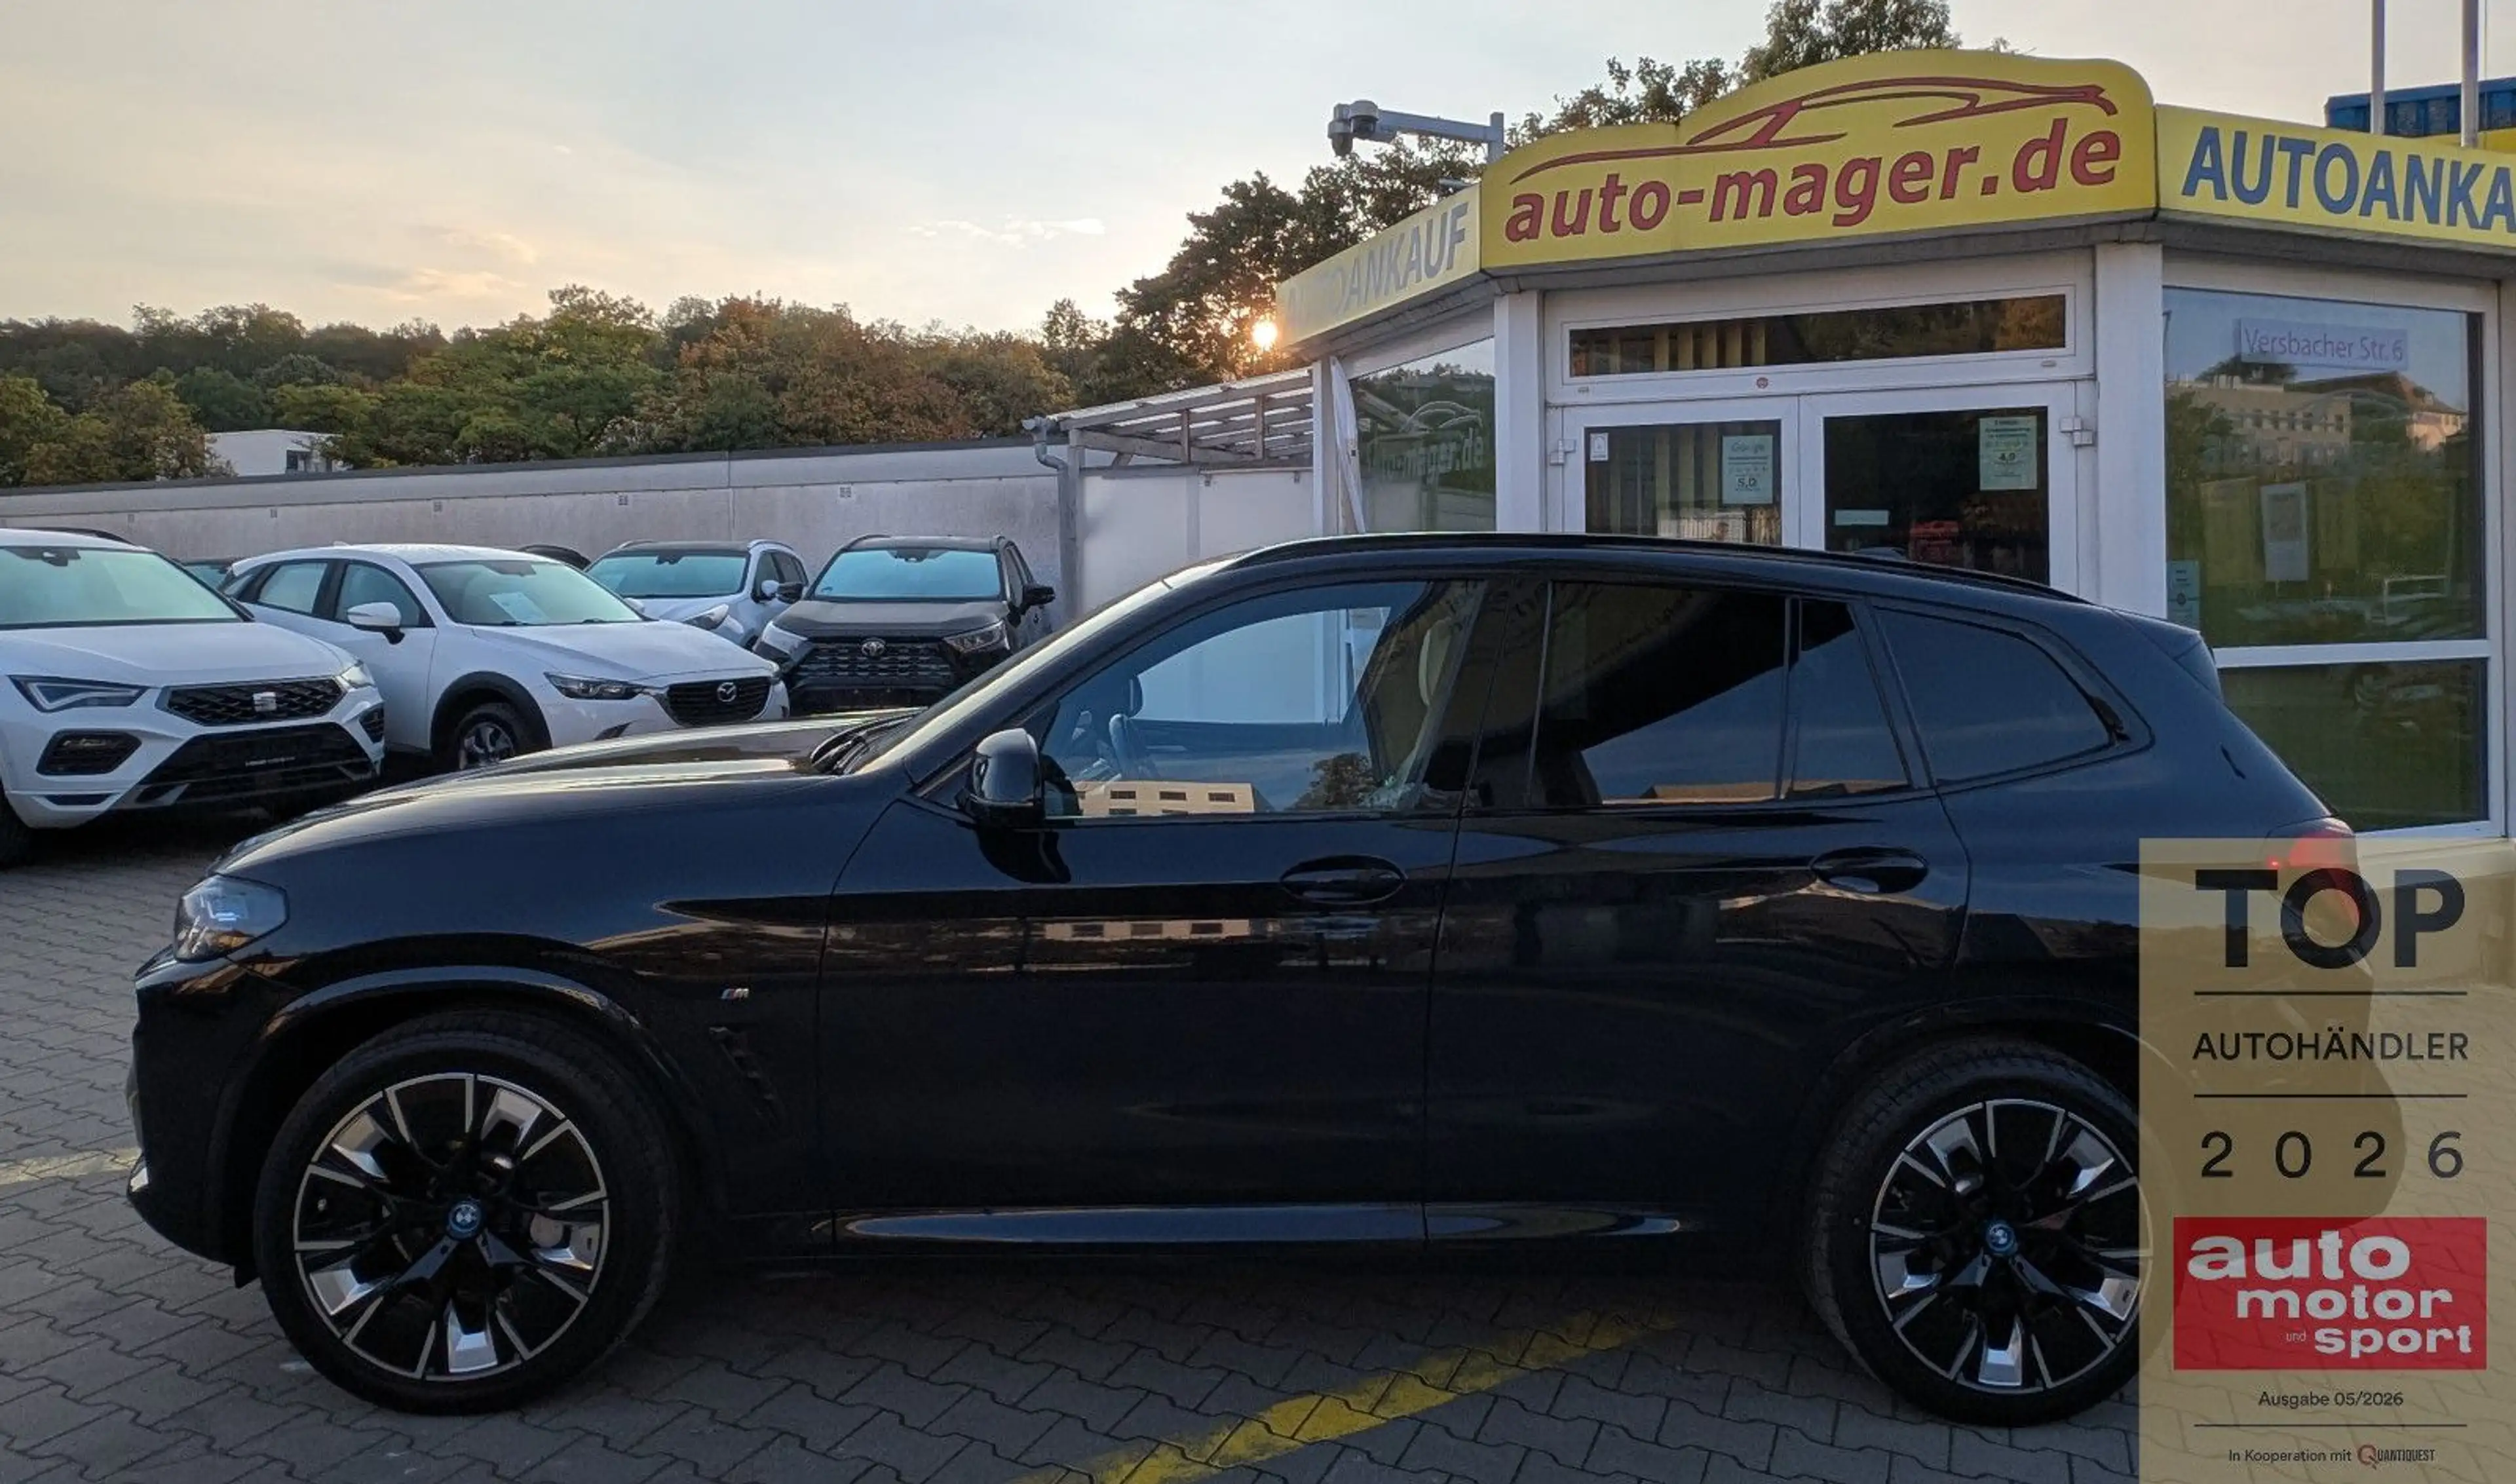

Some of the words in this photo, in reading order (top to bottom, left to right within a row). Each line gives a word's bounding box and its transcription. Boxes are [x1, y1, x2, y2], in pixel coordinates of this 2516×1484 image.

[1504, 118, 2122, 242] auto-mager.de
[1287, 202, 1469, 331] AOANKAUF
[2244, 327, 2354, 360] Versbacher
[2359, 335, 2389, 362] Str.
[2392, 339, 2405, 363] 6
